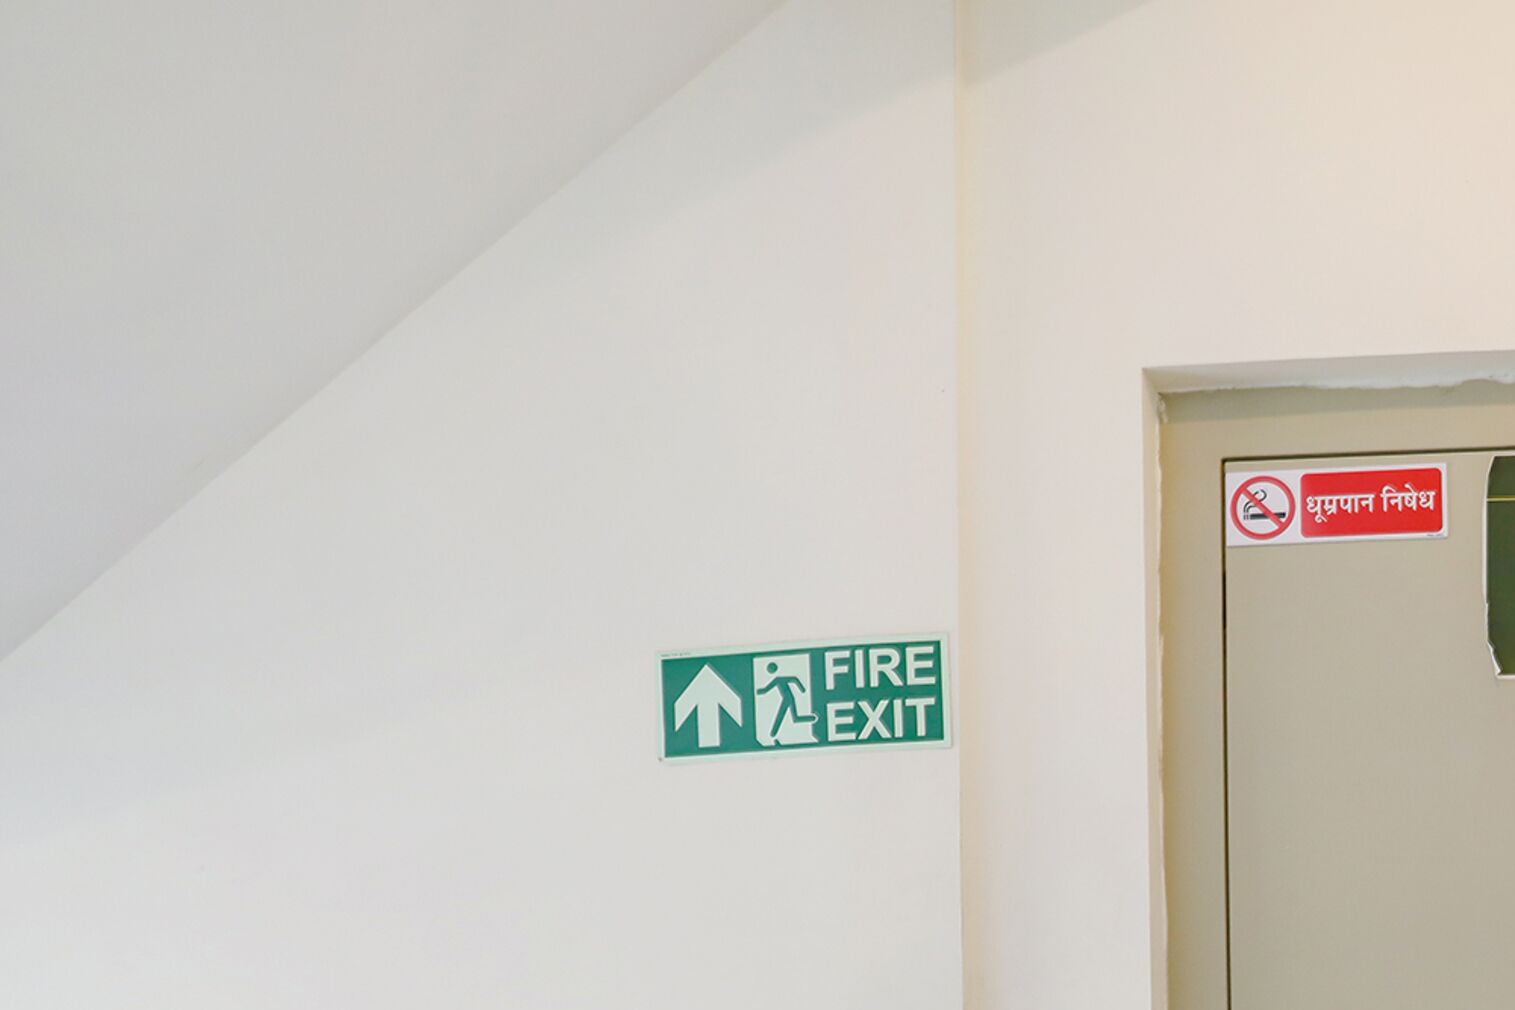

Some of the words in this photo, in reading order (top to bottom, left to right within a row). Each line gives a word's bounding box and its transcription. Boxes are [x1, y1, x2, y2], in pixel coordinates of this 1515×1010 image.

[1306, 493, 1376, 523] धूम्रपान
[1381, 482, 1437, 512] निषेध
[824, 646, 936, 690] FIRE
[826, 697, 936, 742] EXIT
